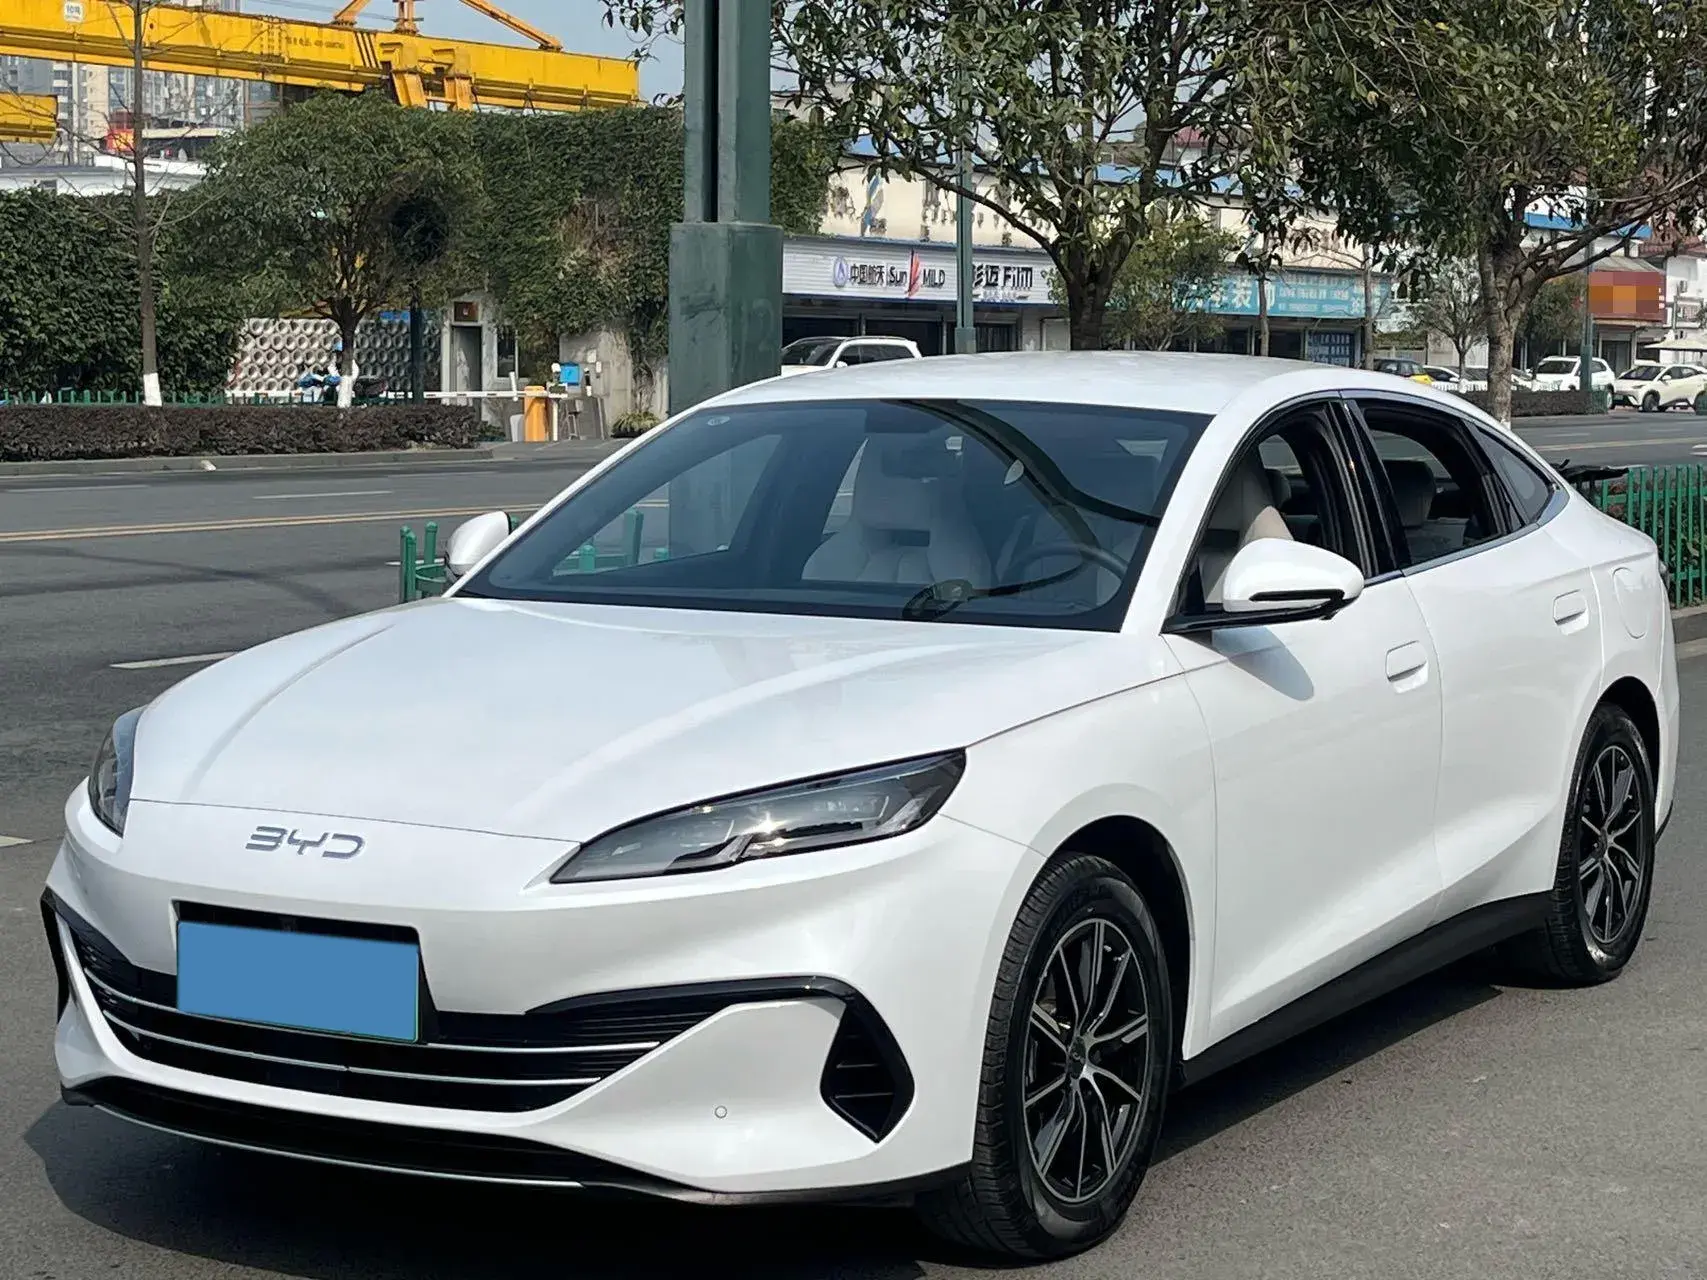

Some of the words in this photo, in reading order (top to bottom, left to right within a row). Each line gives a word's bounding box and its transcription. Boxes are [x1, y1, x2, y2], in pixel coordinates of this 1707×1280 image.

[889, 265, 908, 285] Sun
[923, 267, 946, 286] MILD
[245, 826, 365, 859] BYD
